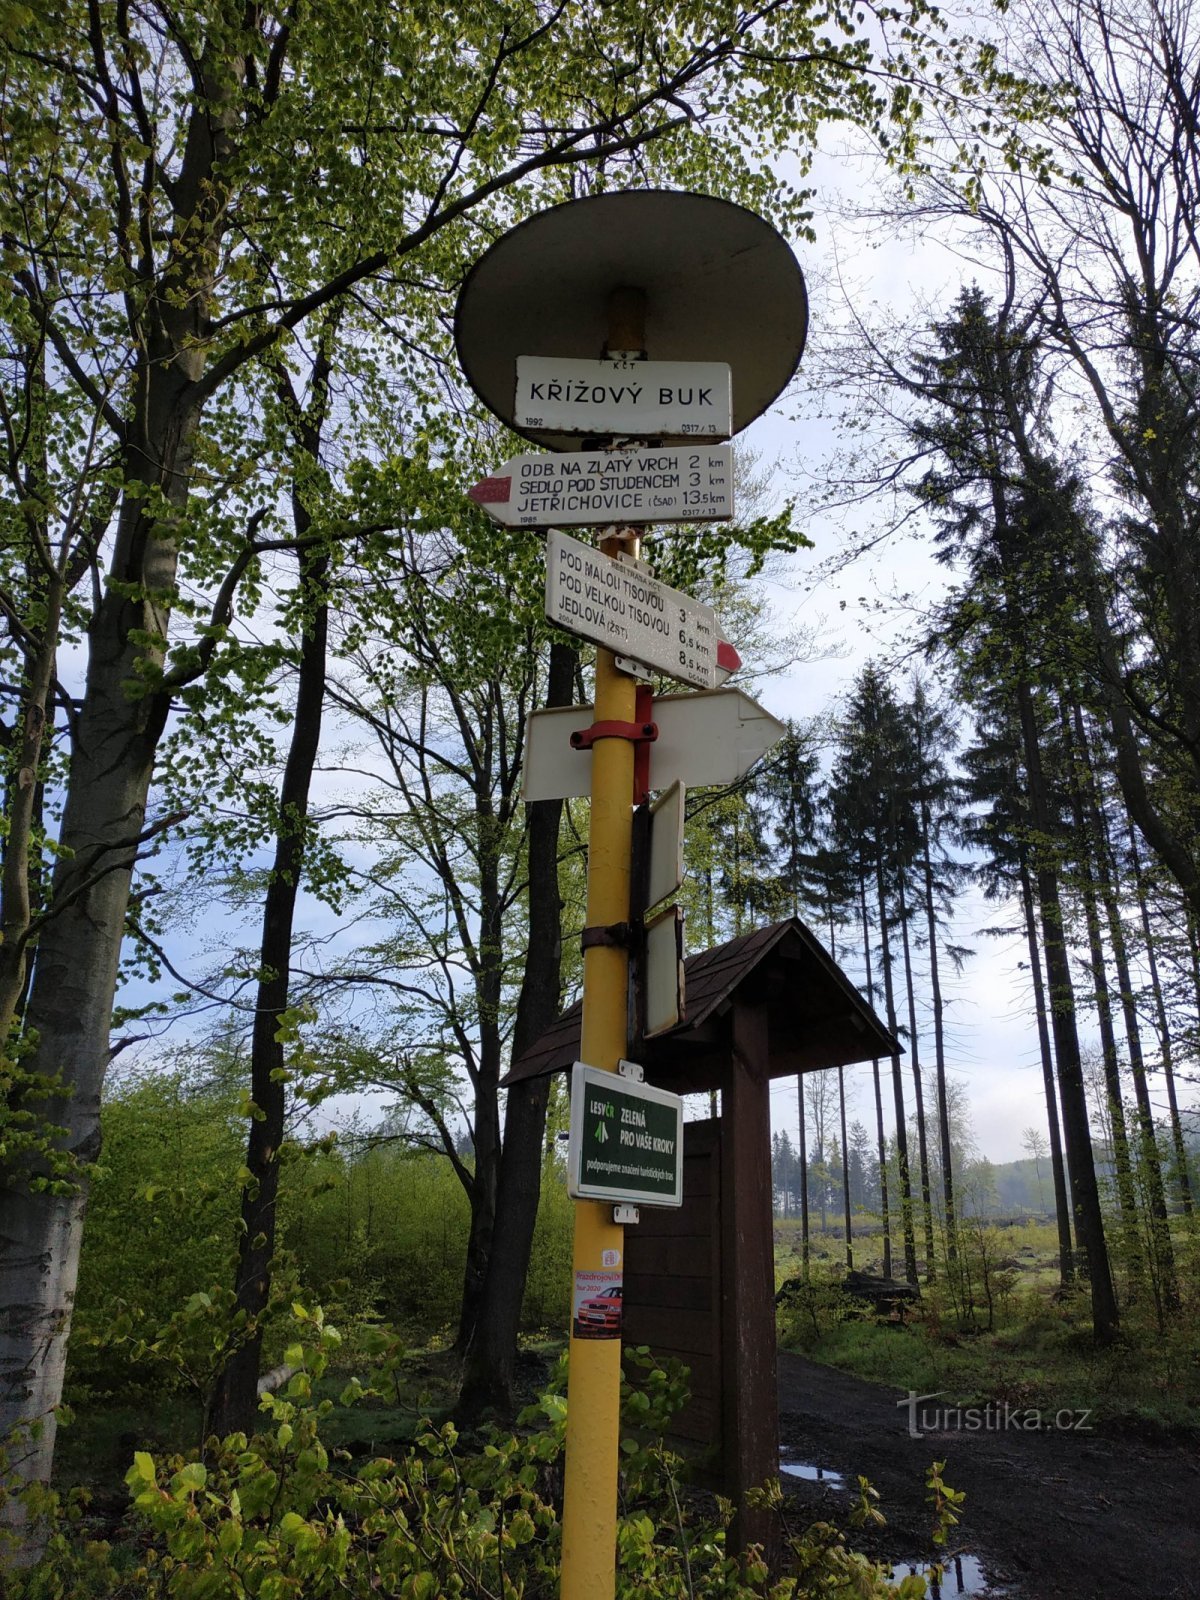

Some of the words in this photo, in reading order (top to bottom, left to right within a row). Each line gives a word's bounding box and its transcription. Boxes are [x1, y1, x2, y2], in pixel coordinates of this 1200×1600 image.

[613, 361, 635, 370] KČT
[530, 378, 643, 404] KŘÍŽOVÝ
[658, 388, 713, 406] BUK
[525, 417, 543, 426] 1992
[561, 462, 581, 475] NA
[587, 456, 632, 474] ZLATÝ
[638, 457, 678, 471] VRCH
[689, 455, 700, 469] 2
[708, 457, 724, 468] km
[519, 479, 563, 495] SEDLO
[567, 478, 595, 493] POD
[600, 474, 680, 491] STUDENCEM
[689, 472, 701, 487] 3
[709, 475, 725, 486] km
[517, 493, 643, 512] JETŘICHOVICE
[648, 496, 677, 507] (ČSAD)
[560, 549, 582, 572] POD
[585, 562, 621, 590] MALOU
[624, 580, 664, 612] TISOVOU
[679, 608, 686, 623] 3
[697, 620, 710, 635] km
[558, 613, 574, 625] 2004
[559, 571, 581, 594] POD
[585, 583, 625, 615] VELKOU
[629, 604, 670, 636] TISOVOU
[679, 629, 693, 648] 6,5
[696, 640, 709, 656] km
[559, 595, 606, 627] JEDLOVÁ
[607, 620, 628, 640] (ŽST)
[679, 650, 694, 669] 8,5
[696, 661, 709, 676] km
[621, 1107, 646, 1128] ZELENÁ
[620, 1129, 635, 1147] PRO
[636, 1131, 652, 1150] VAŠE
[652, 1137, 674, 1155] KROKY
[587, 1157, 621, 1175] podporujeme
[621, 1163, 640, 1176] značení
[640, 1165, 665, 1182] turistických
[664, 1169, 674, 1181] tras
